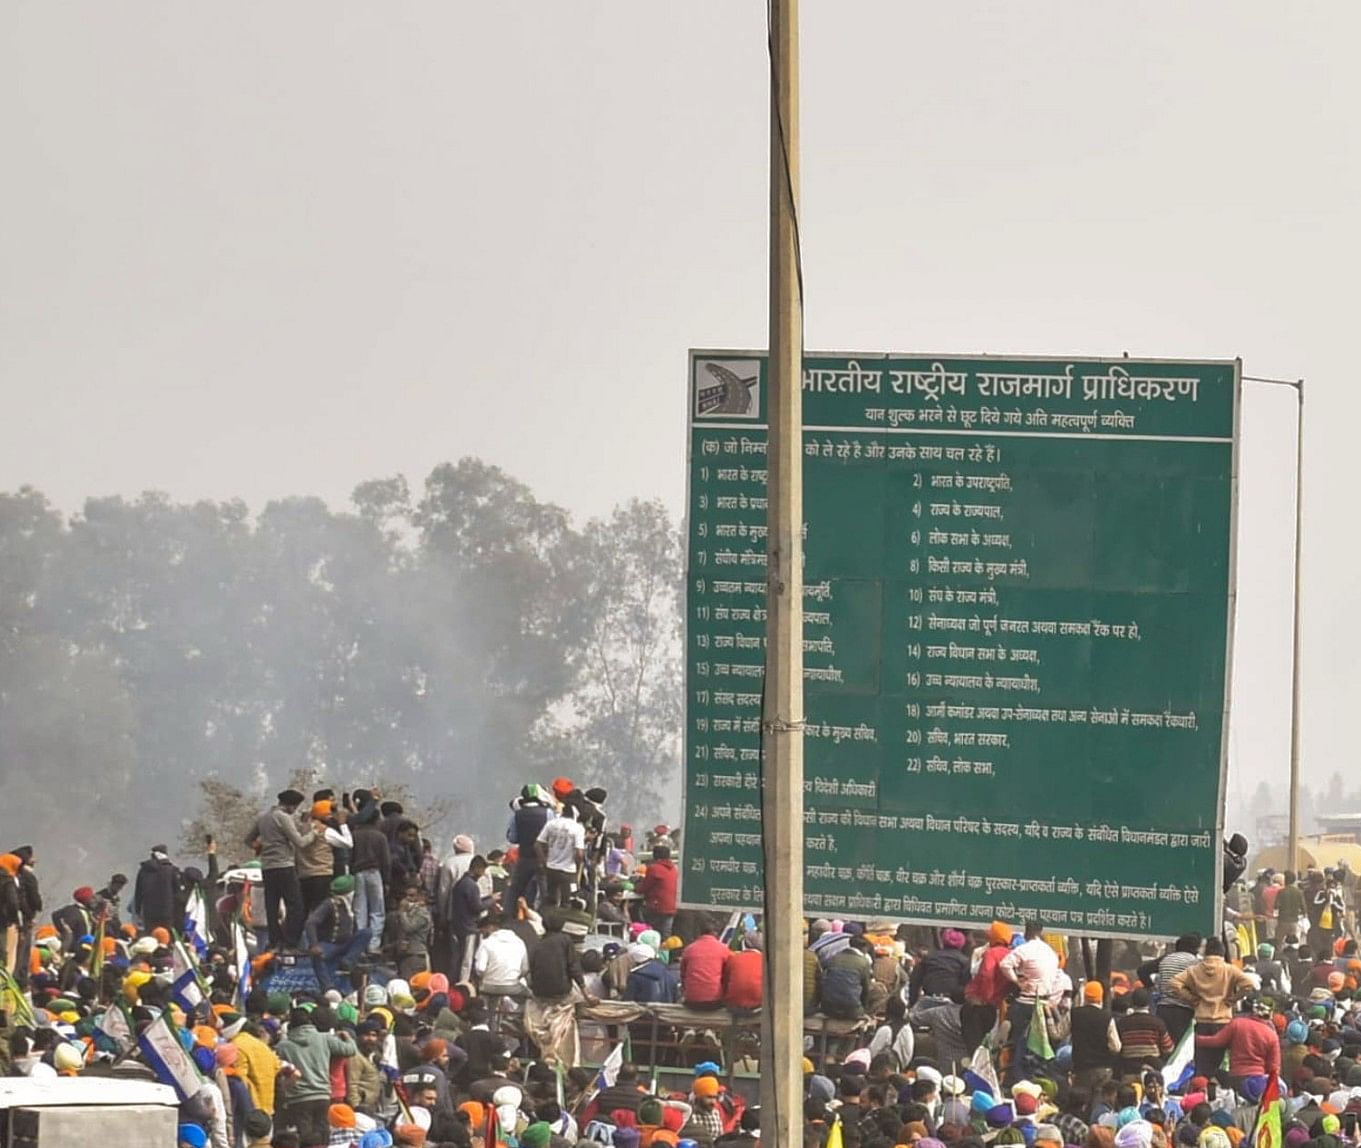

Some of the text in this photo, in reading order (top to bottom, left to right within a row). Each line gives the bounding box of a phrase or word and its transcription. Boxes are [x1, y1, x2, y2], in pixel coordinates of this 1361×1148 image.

[889, 361, 968, 401] राष्ट्रीय
[975, 364, 1074, 399] राजमार्ग
[1081, 365, 1200, 402] प्राधिकरण
[887, 408, 916, 427] शुल्क
[918, 405, 943, 422] भरने
[946, 405, 957, 423] से
[981, 407, 1001, 425] दिये
[1003, 407, 1022, 425] गये
[1025, 408, 1048, 426] अति
[805, 440, 820, 457] को
[823, 440, 833, 457] ले
[865, 441, 885, 459] और
[888, 442, 917, 460] उनके
[968, 444, 983, 462] रहे
